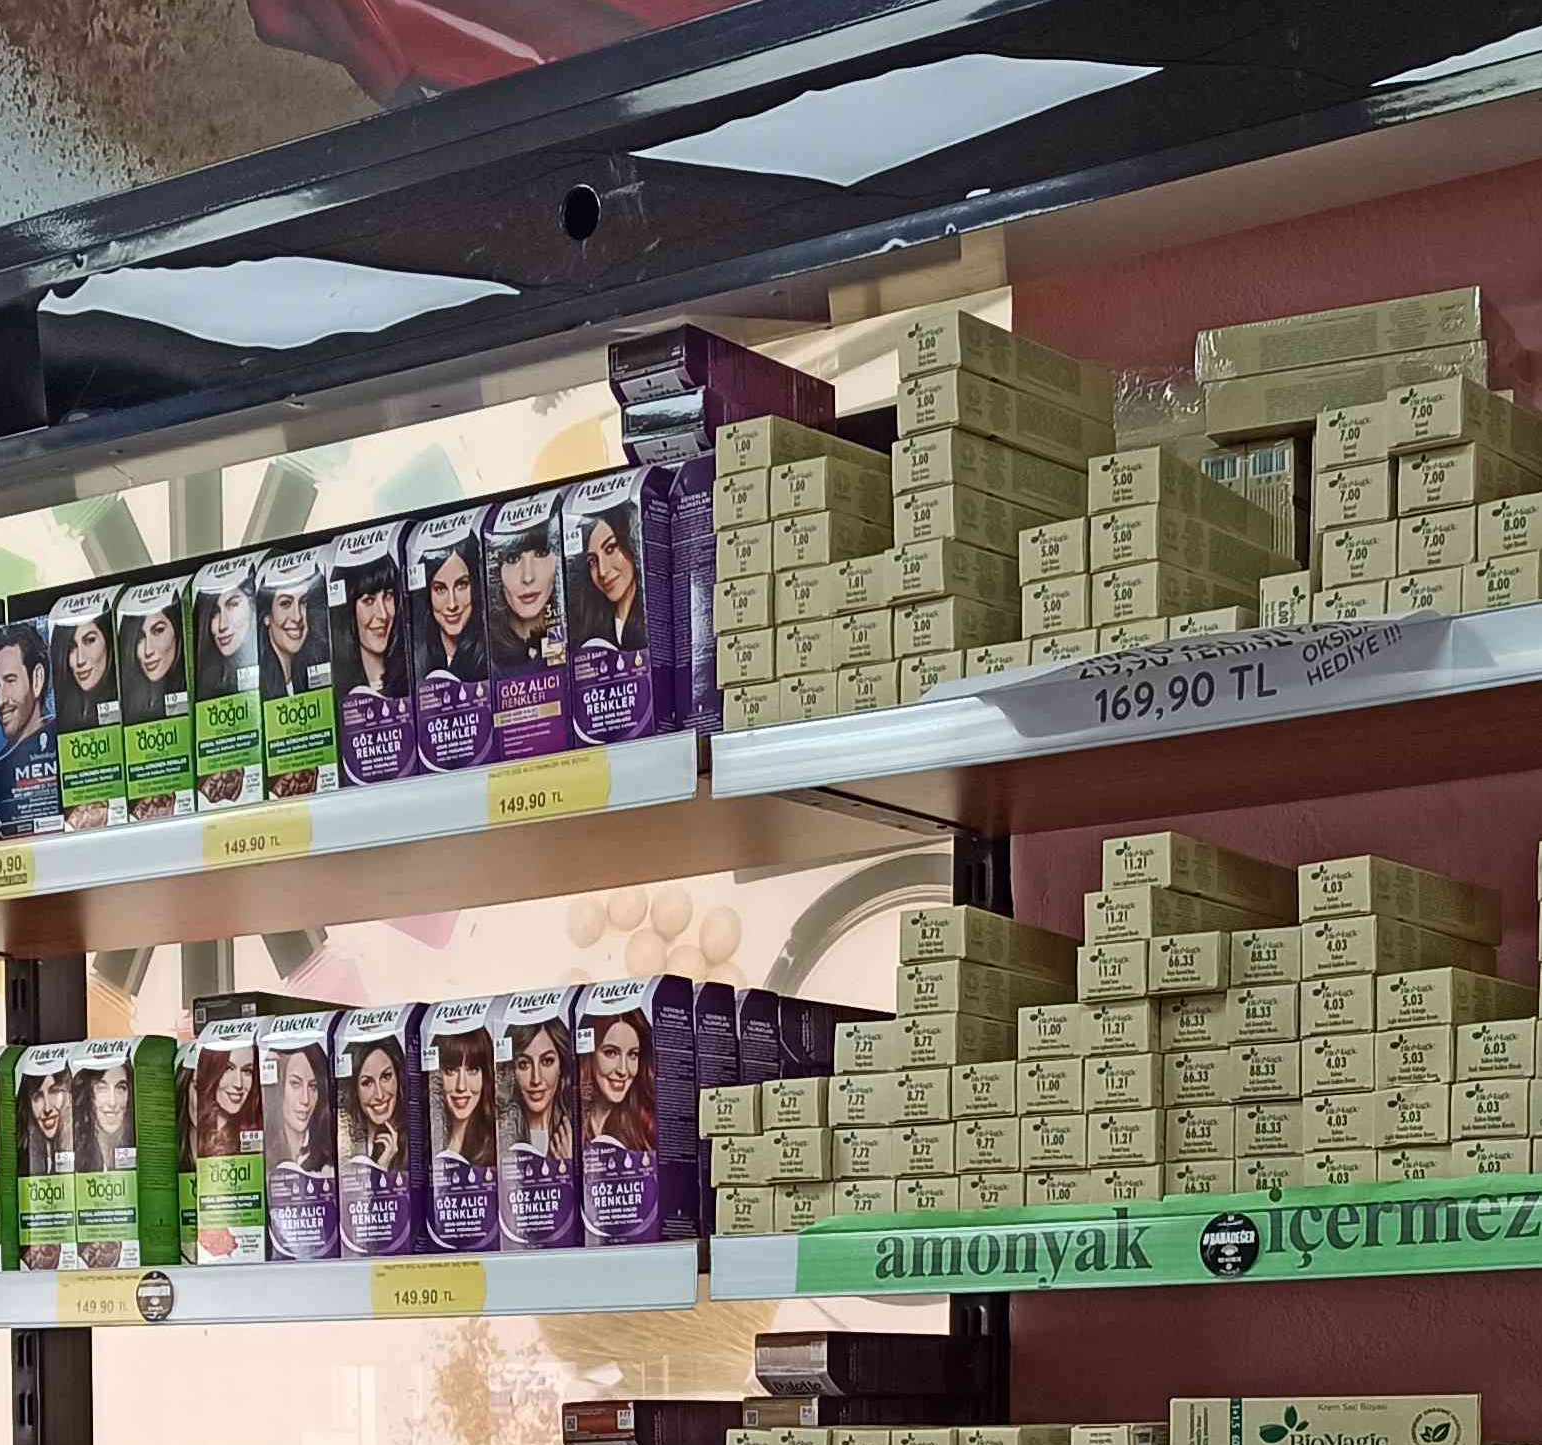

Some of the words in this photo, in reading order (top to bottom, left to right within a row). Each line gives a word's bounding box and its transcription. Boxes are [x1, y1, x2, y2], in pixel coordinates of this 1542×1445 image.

[578, 474, 632, 498] Palette
[1307, 640, 1380, 686] HEDİYE
[1095, 671, 1215, 722] 169,90
[1229, 663, 1278, 700] TL
[587, 696, 636, 716] RENKLER
[499, 792, 546, 815] 149.90
[552, 792, 563, 803] TL
[223, 836, 266, 856] 149.90
[591, 982, 644, 1002] Palette
[874, 1205, 1153, 1289] amonyak
